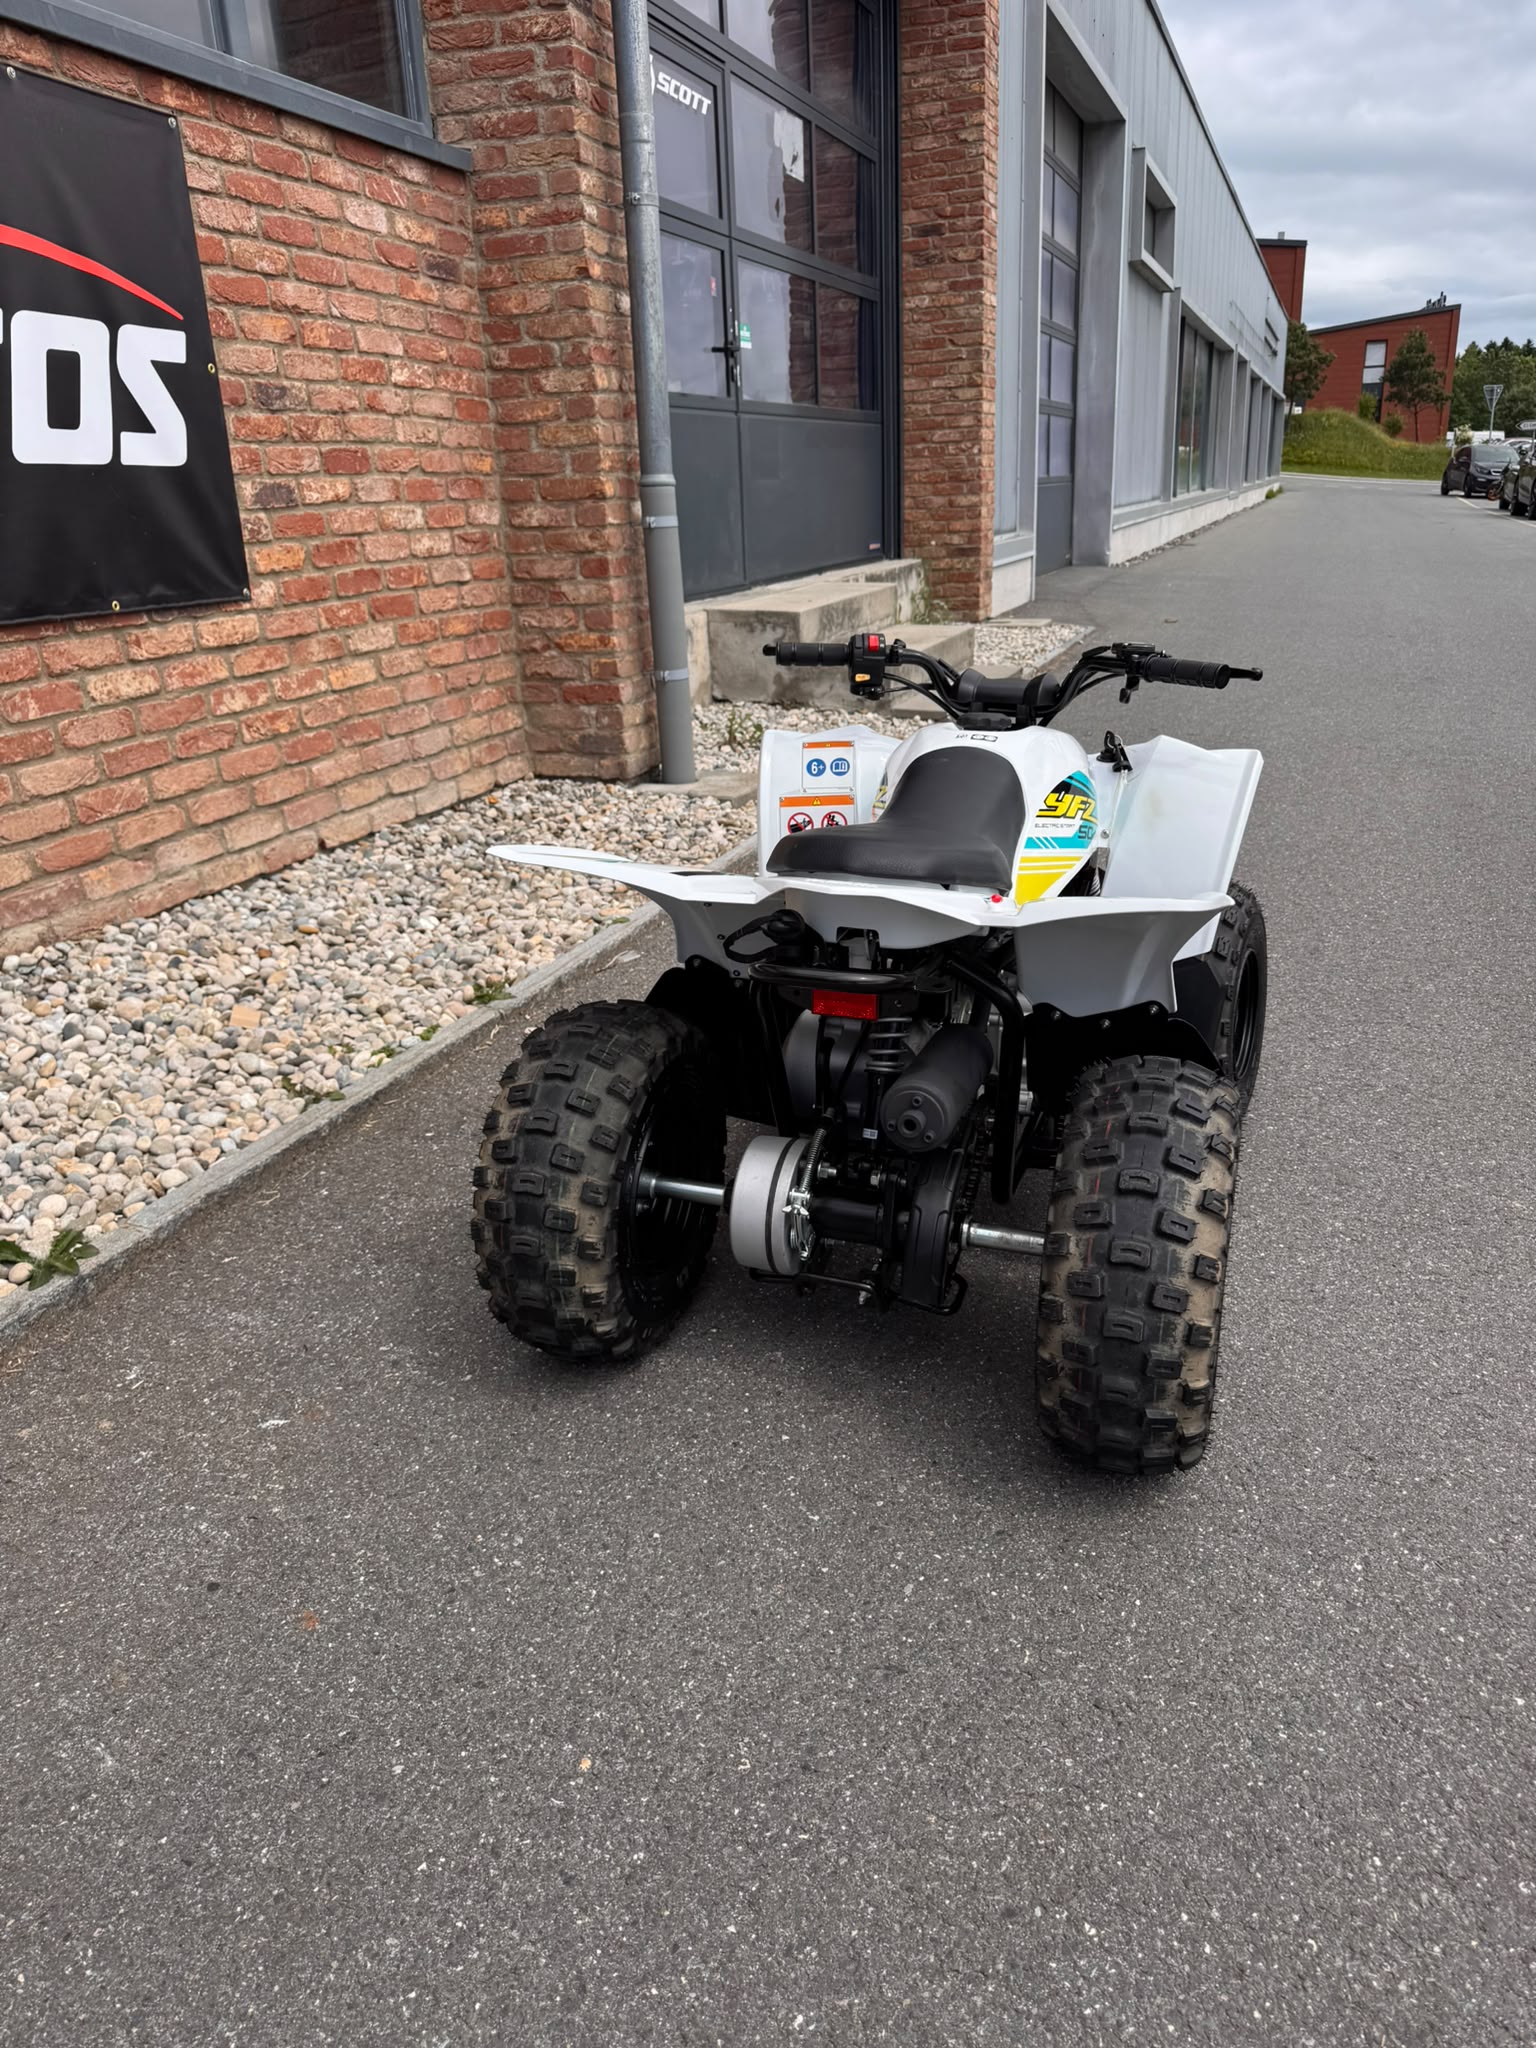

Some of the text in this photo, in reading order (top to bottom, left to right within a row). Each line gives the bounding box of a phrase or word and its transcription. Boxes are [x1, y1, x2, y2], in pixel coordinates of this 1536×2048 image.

[656, 72, 711, 115] SCOTT
[0, 308, 187, 467] OS
[811, 762, 824, 774] 6+
[1036, 793, 1098, 824] YFZ
